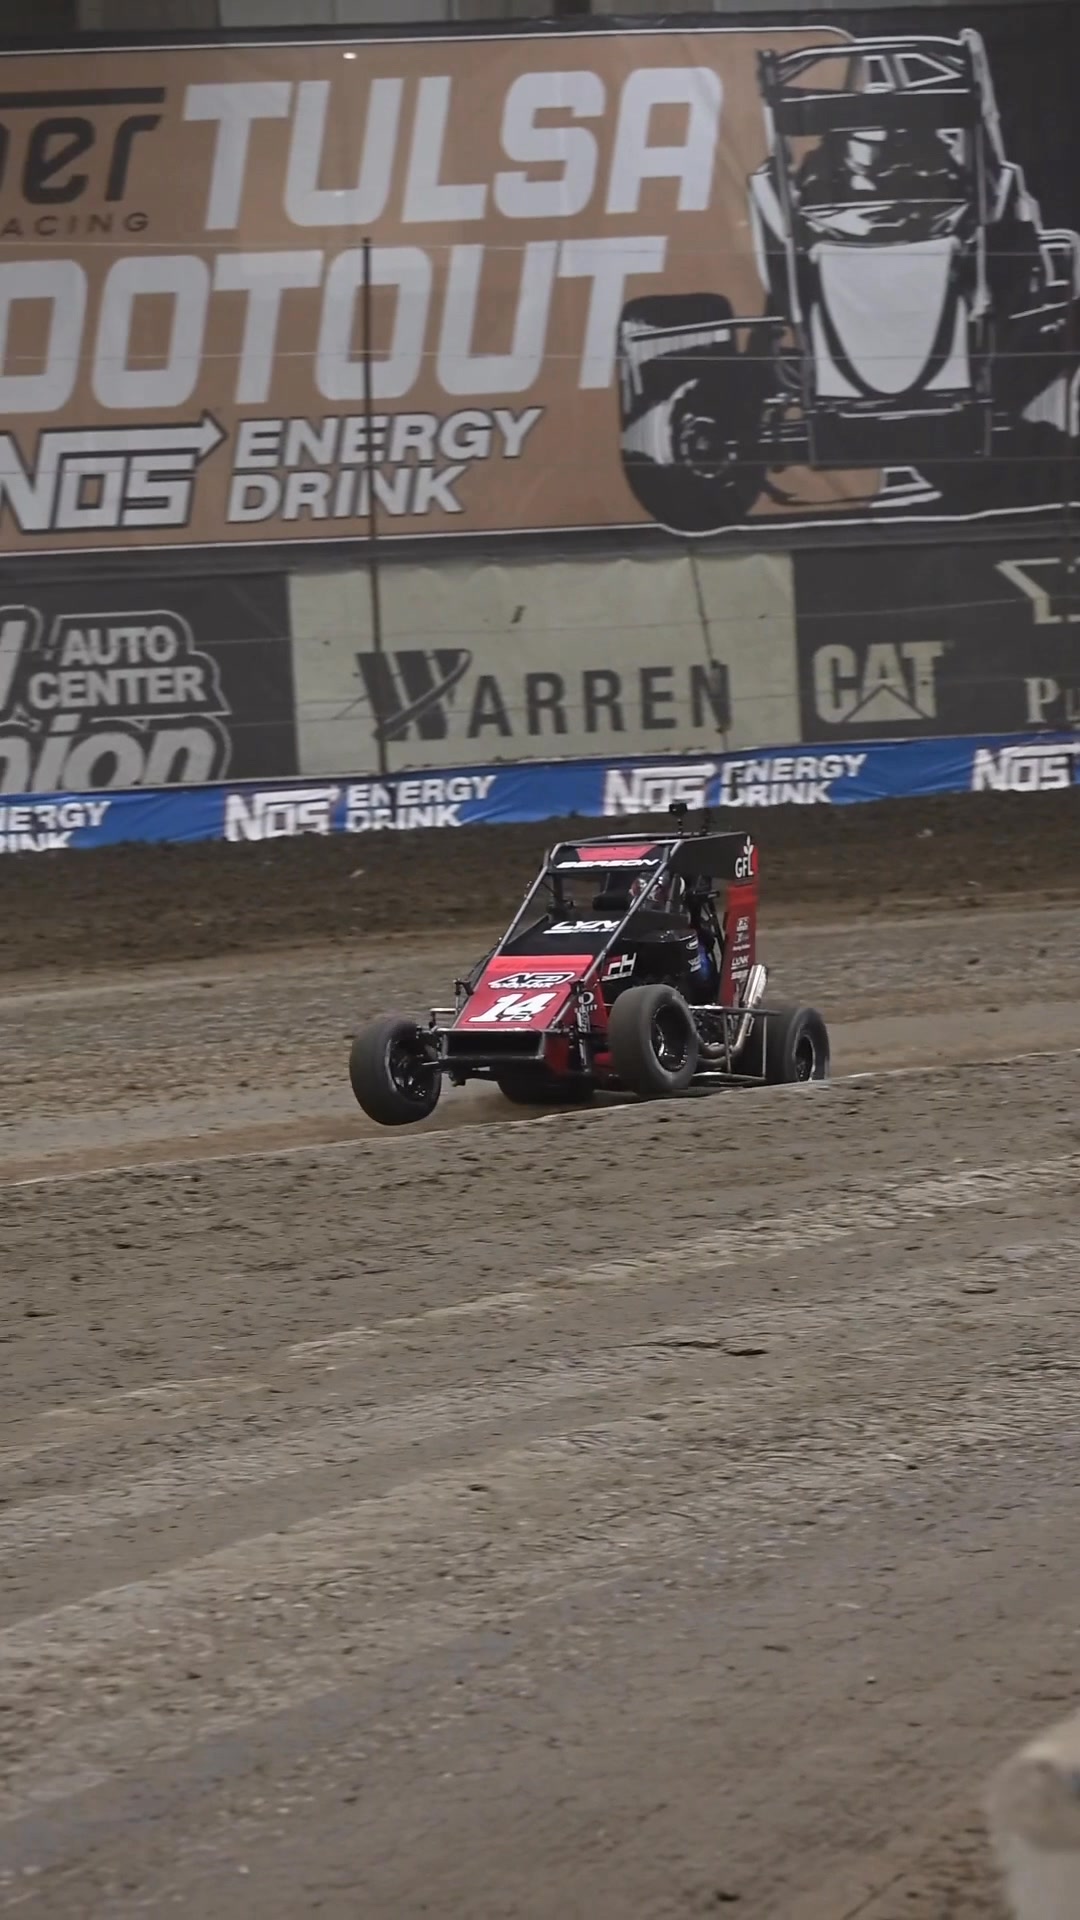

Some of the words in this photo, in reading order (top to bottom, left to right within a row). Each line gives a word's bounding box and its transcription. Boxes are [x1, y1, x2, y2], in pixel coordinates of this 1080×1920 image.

[0, 114, 162, 205] er
[183, 67, 723, 230] TULSA
[233, 408, 544, 469] ENERGY
[227, 467, 465, 523] DRINK
[60, 625, 178, 666] AUTO
[29, 666, 206, 709] CENTER
[356, 648, 731, 742] WARREN
[813, 640, 943, 724] CAT
[603, 763, 716, 816] NOS
[972, 742, 1080, 791] NOS
[224, 786, 340, 842] NOS
[346, 775, 497, 809] ENERGY
[735, 852, 754, 878] GFL
